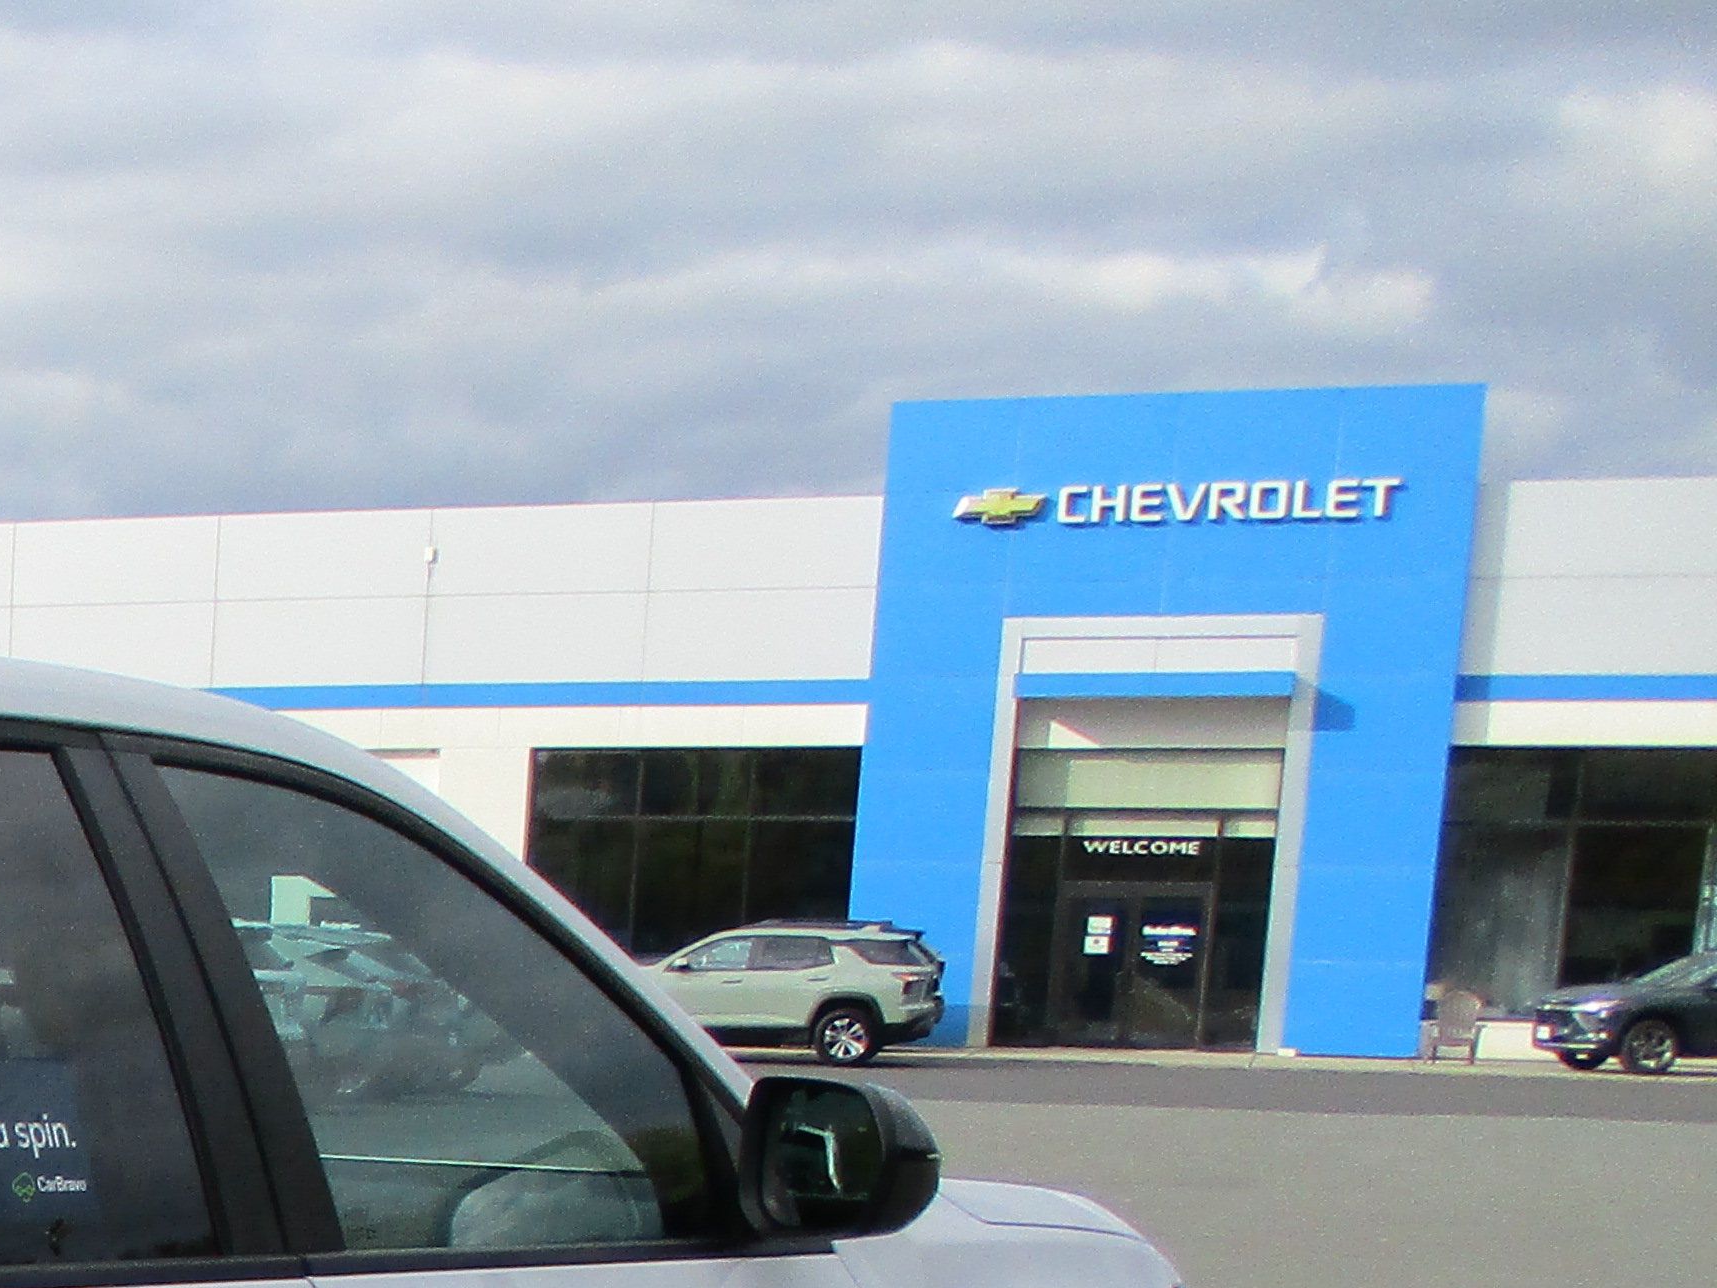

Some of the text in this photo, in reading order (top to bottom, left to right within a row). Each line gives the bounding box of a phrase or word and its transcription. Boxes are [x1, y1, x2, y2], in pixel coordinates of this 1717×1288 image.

[1057, 477, 1403, 525] CHEVROLET
[1083, 840, 1201, 856] WELCOME
[15, 1113, 77, 1159] spin.
[36, 1175, 87, 1193] CarBravo
